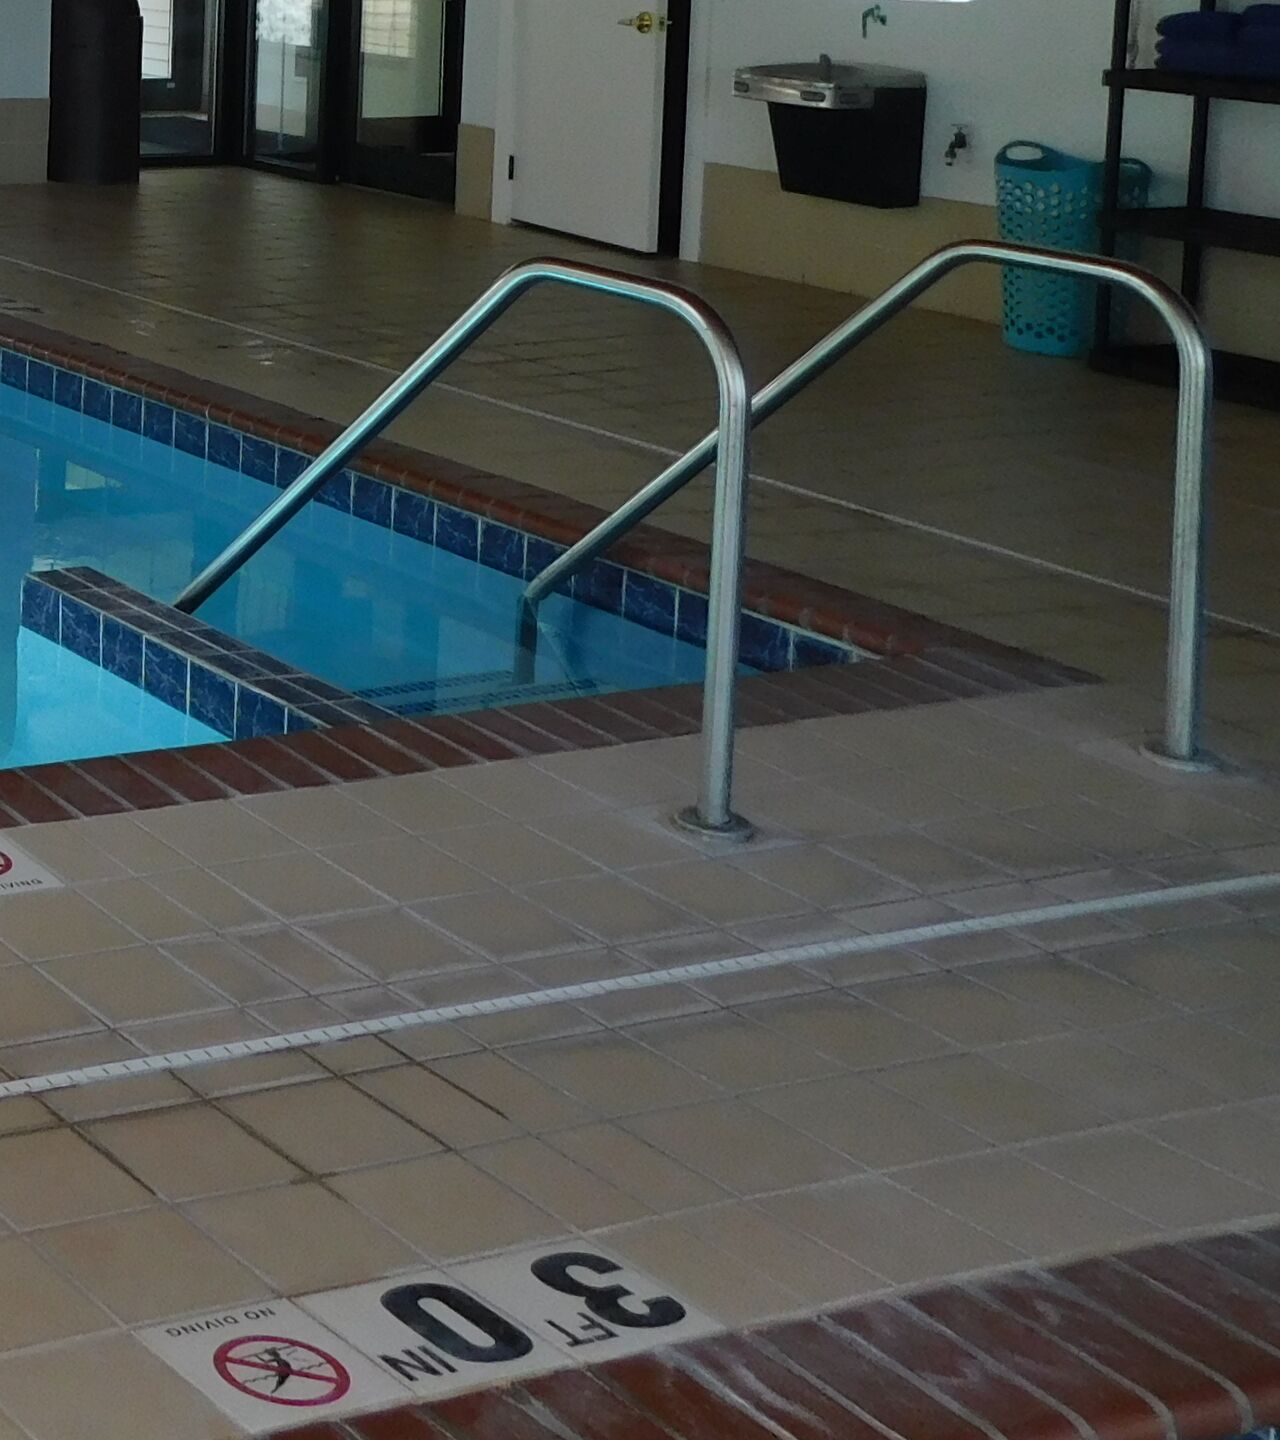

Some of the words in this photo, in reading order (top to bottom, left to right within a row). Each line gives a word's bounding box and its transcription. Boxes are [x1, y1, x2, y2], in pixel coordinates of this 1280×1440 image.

[530, 1251, 687, 1329] 3
[164, 1315, 240, 1338] DIVING
[243, 1307, 277, 1321] NO
[380, 1282, 534, 1363] 0
[544, 1311, 620, 1348] FT
[377, 1345, 459, 1382] IN
